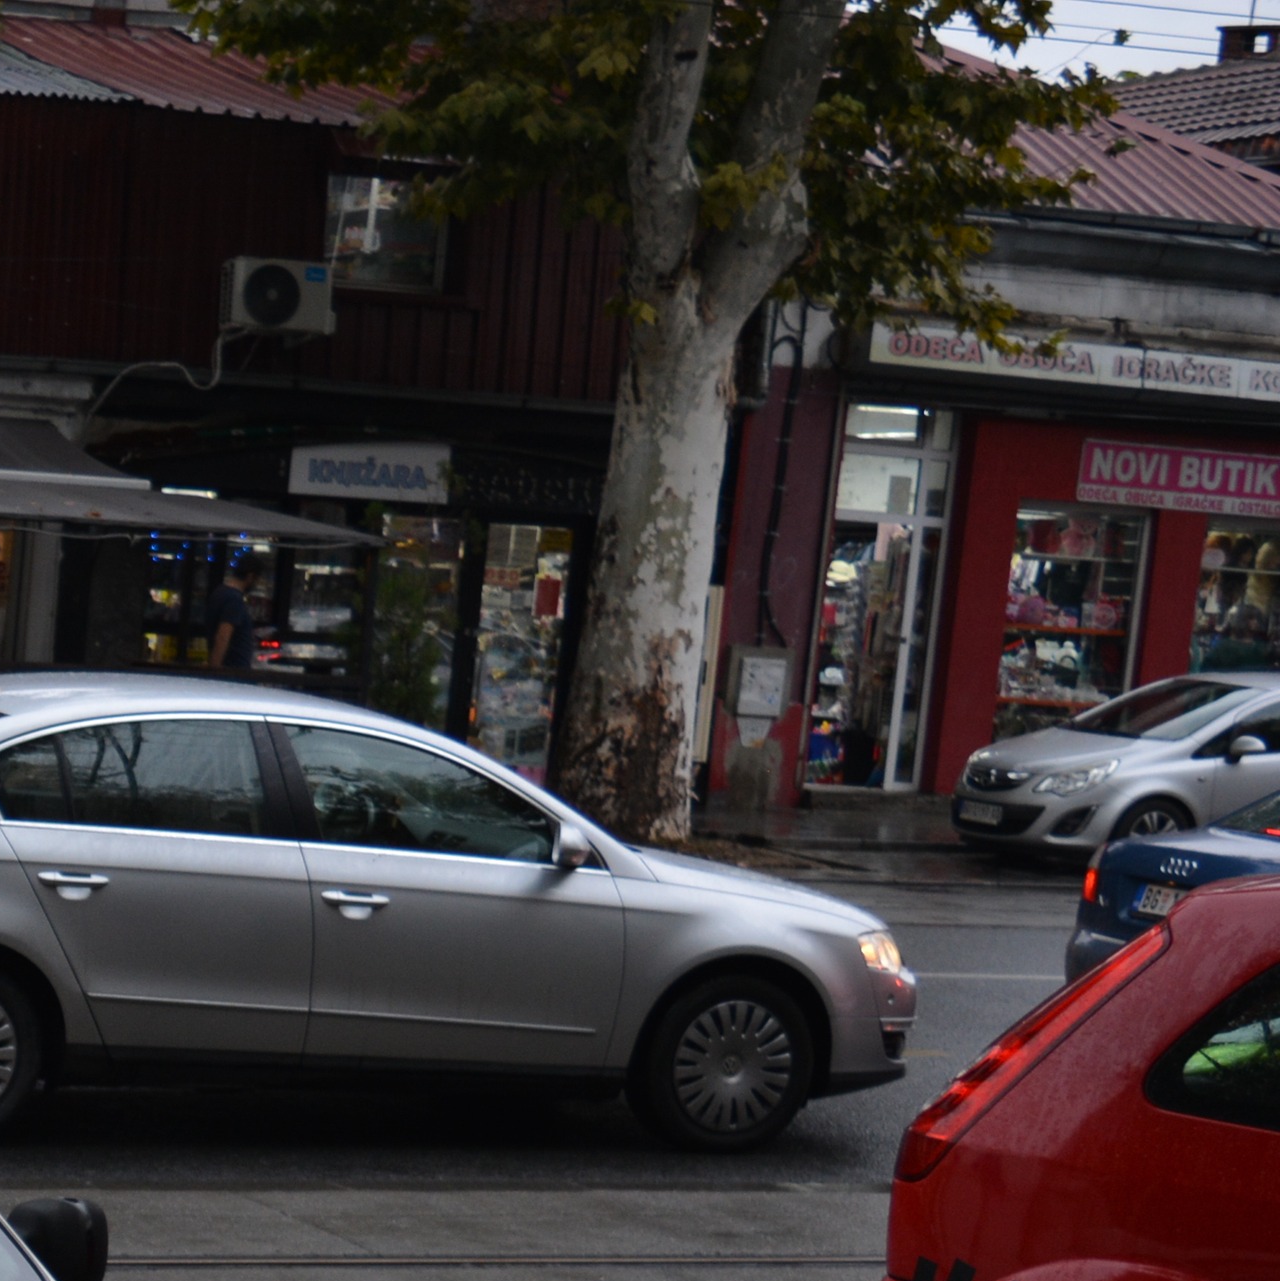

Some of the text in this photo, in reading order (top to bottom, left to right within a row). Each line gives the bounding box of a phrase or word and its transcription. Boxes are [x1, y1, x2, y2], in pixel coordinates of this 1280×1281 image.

[1113, 354, 1233, 390] IGRAČKE
[1089, 447, 1279, 496] NOVI BUTIK
